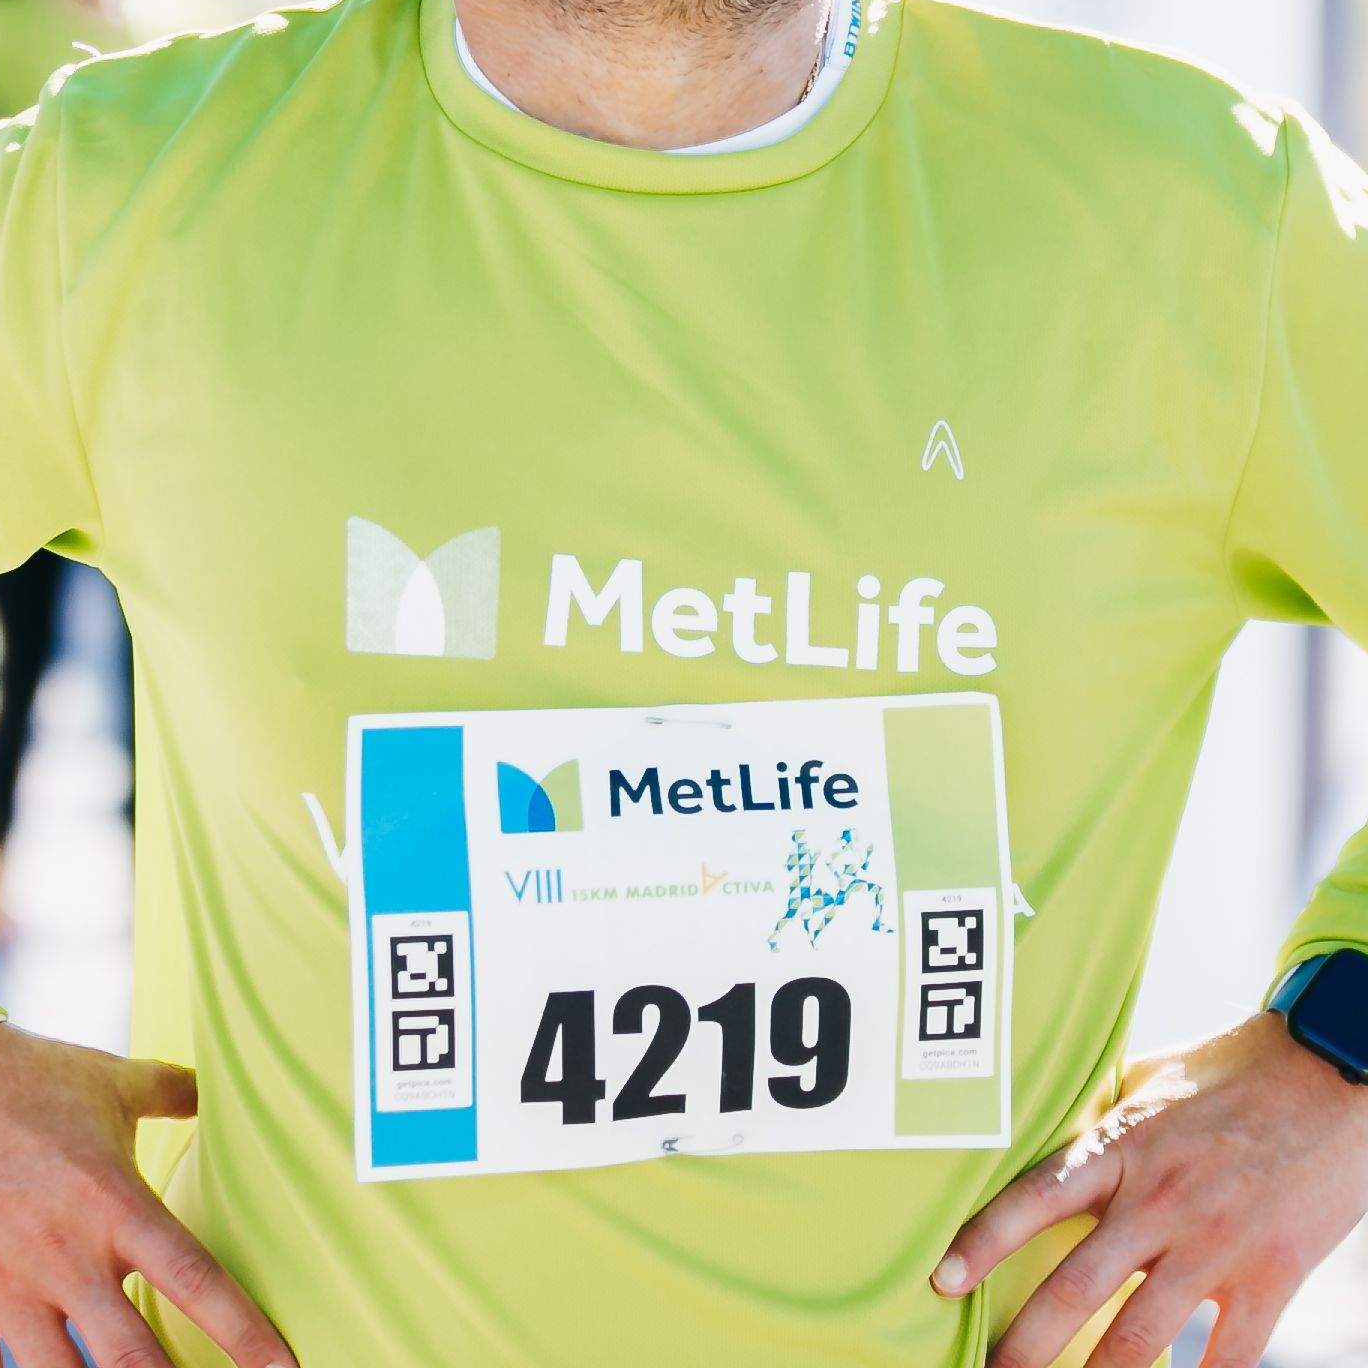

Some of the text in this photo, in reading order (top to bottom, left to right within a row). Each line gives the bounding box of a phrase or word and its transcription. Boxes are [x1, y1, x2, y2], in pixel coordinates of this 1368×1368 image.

[543, 552, 998, 677] MetLife
[608, 759, 859, 818] MetLife
[504, 868, 563, 904] VIII
[571, 886, 619, 902] 15KM
[626, 883, 699, 900] MADRID
[520, 976, 852, 1126] 4219
